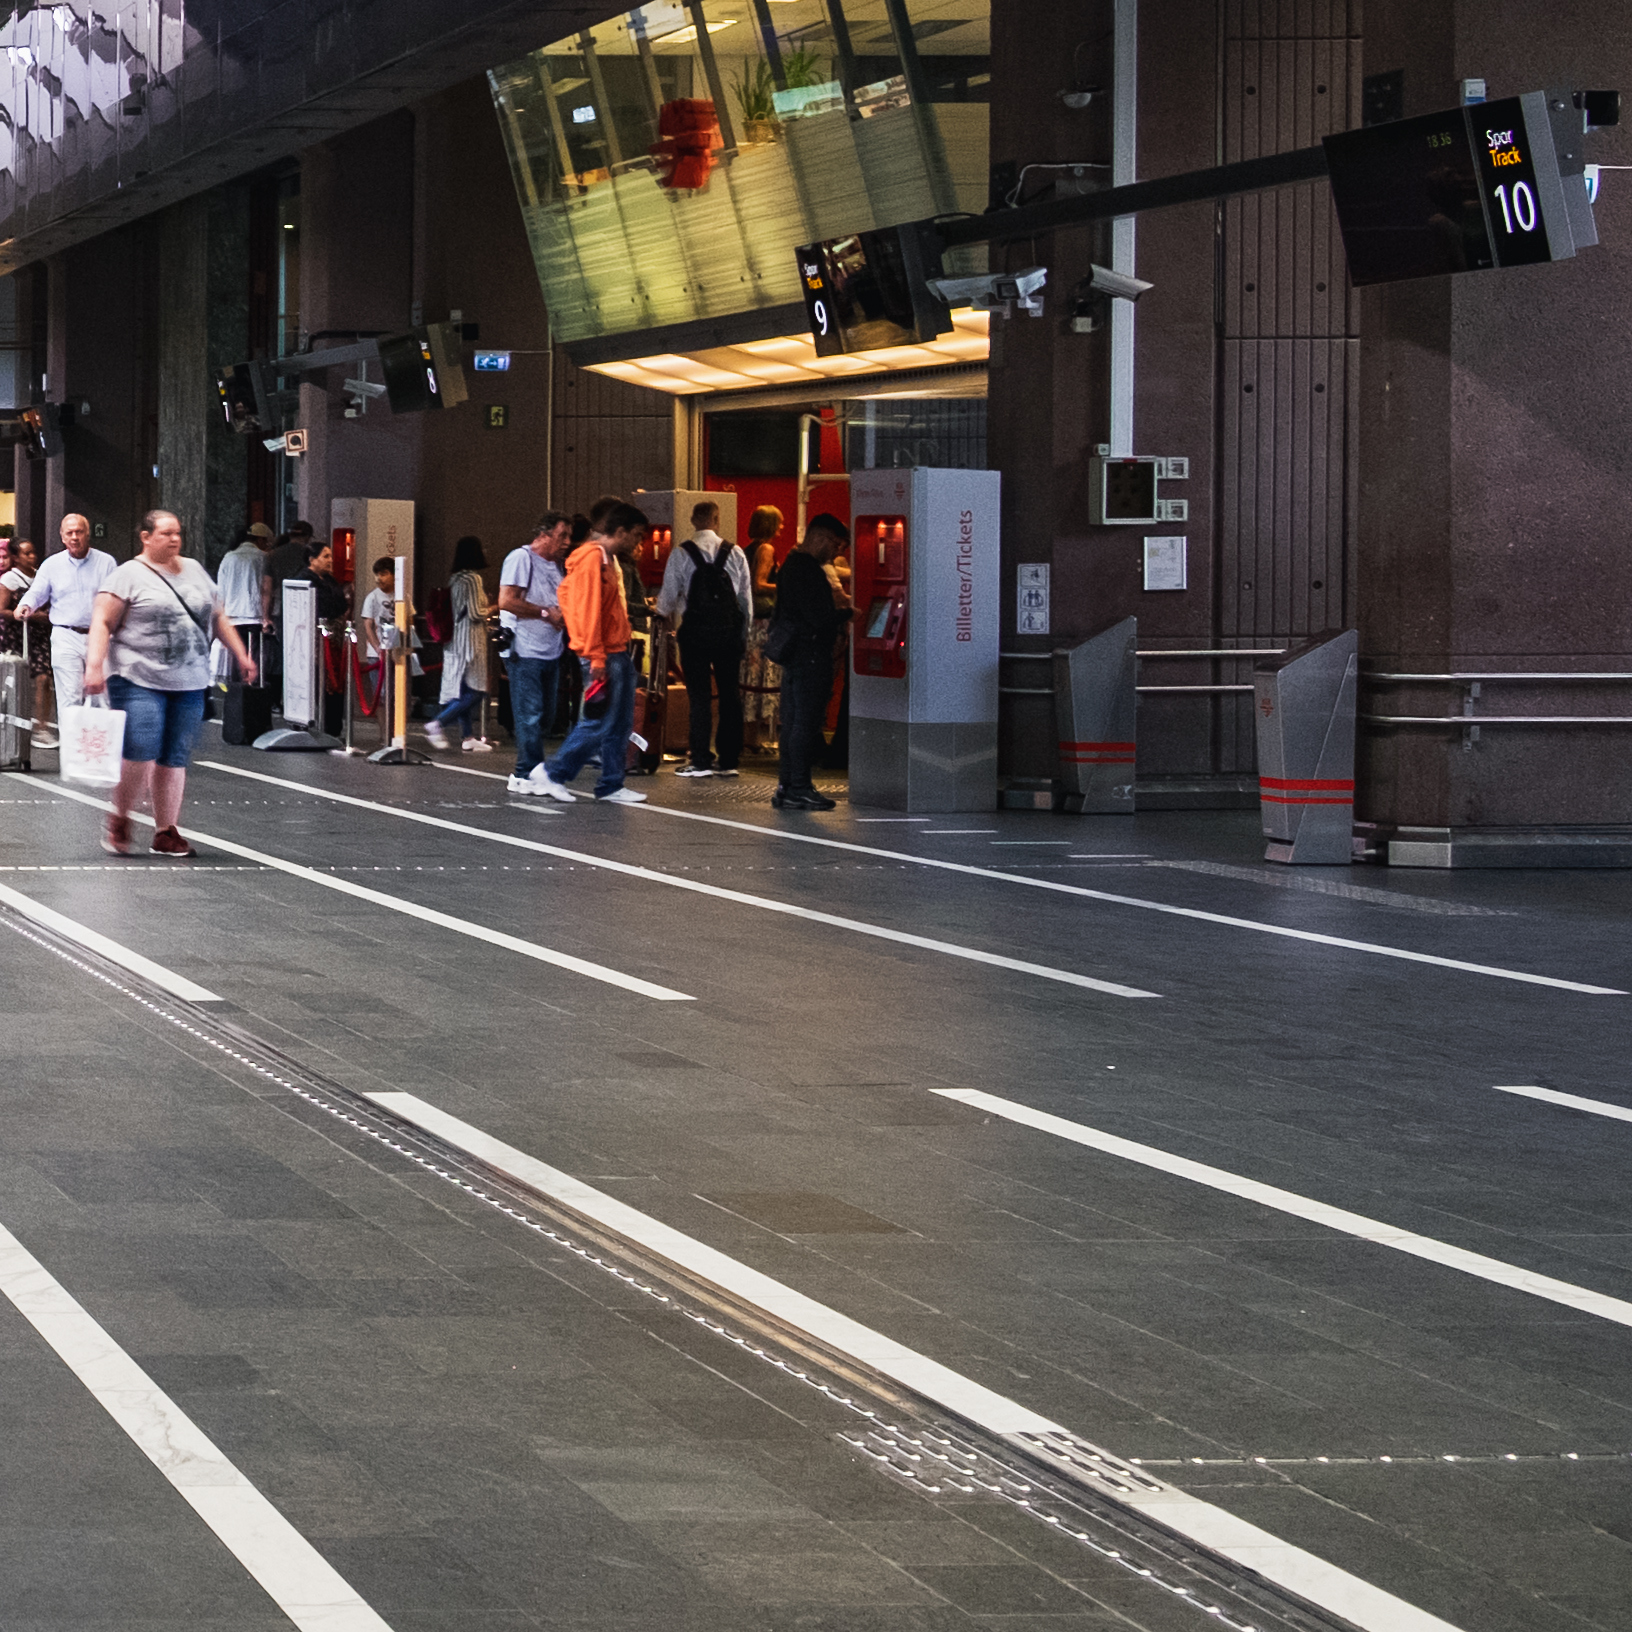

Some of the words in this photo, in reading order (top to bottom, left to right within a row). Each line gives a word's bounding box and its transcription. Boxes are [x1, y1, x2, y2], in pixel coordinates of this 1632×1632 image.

[1486, 129, 1513, 150] Spor
[1489, 146, 1522, 167] Track
[1494, 180, 1536, 234] 10
[814, 300, 828, 336] 9
[956, 509, 973, 643] Billetter/Tickets
